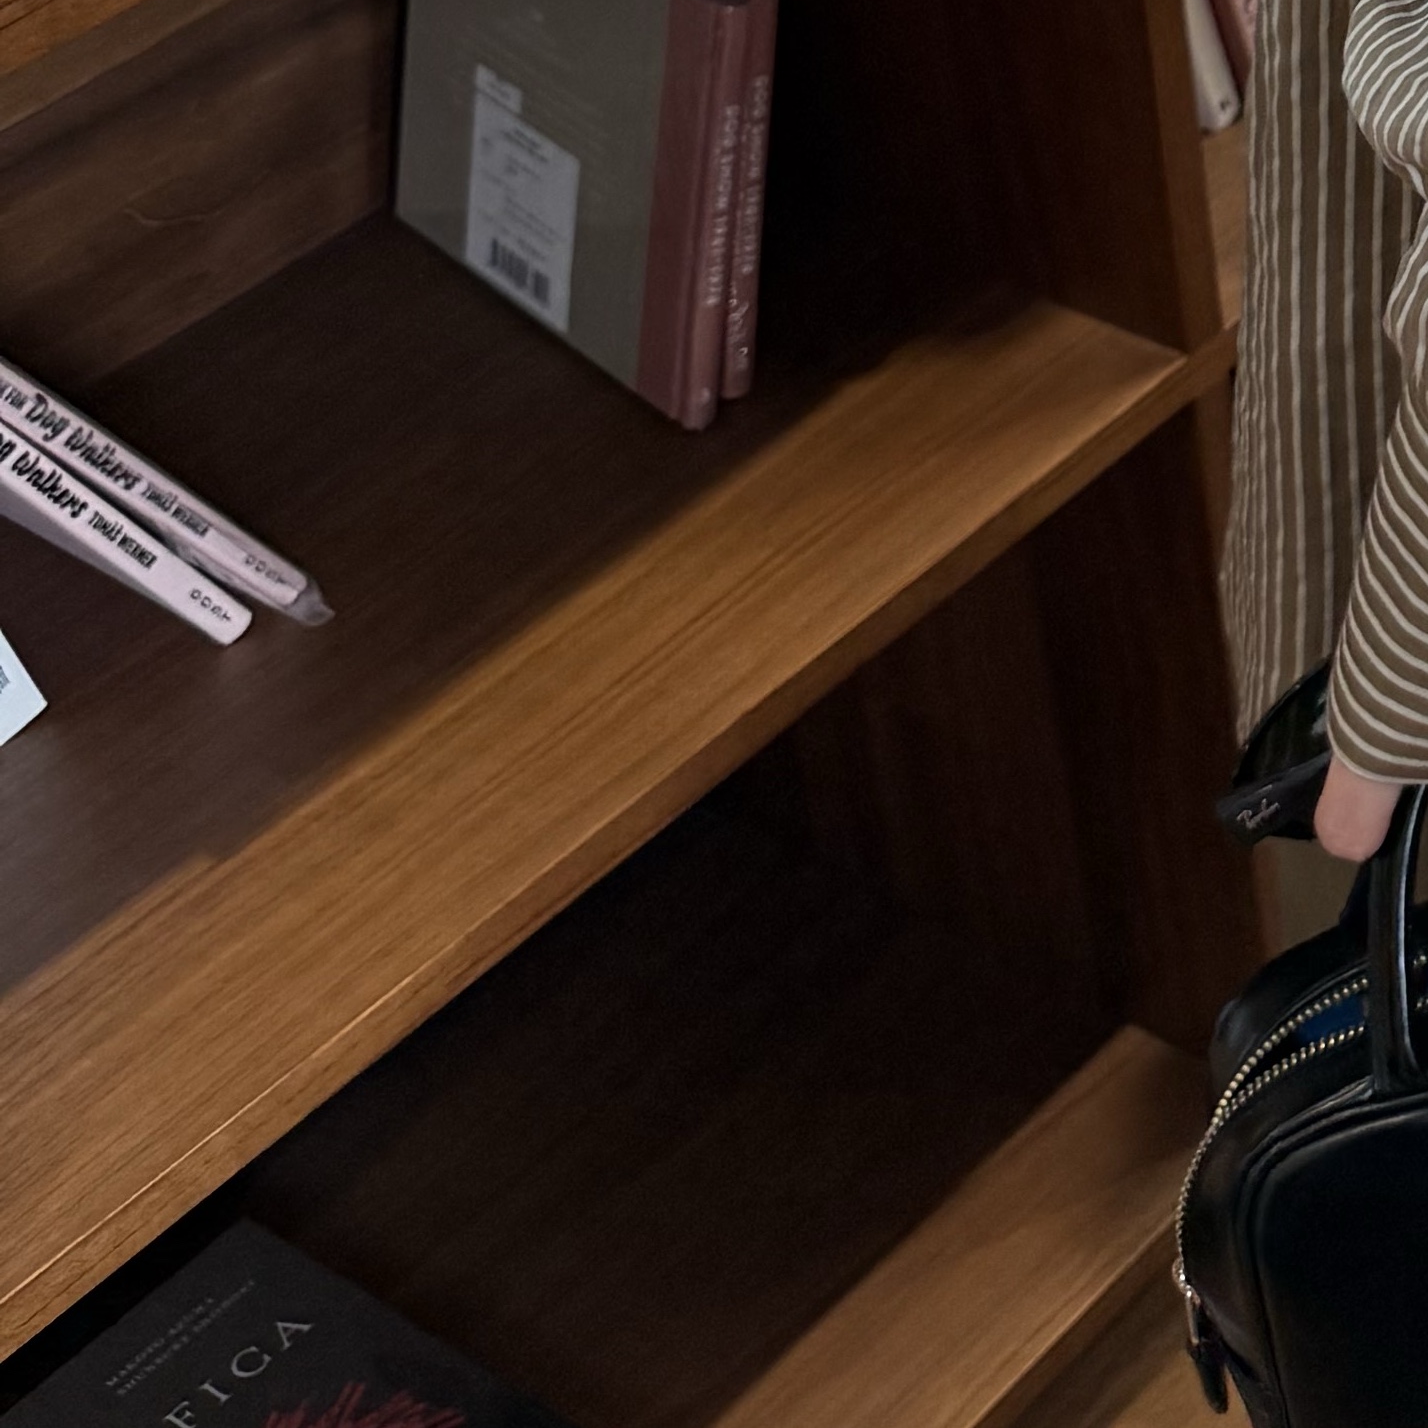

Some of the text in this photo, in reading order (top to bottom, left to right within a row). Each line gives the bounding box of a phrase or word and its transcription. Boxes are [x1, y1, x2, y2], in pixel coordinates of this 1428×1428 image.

[25, 393, 70, 442] Dog
[64, 426, 142, 491] Walkers
[12, 451, 88, 518] Walkers
